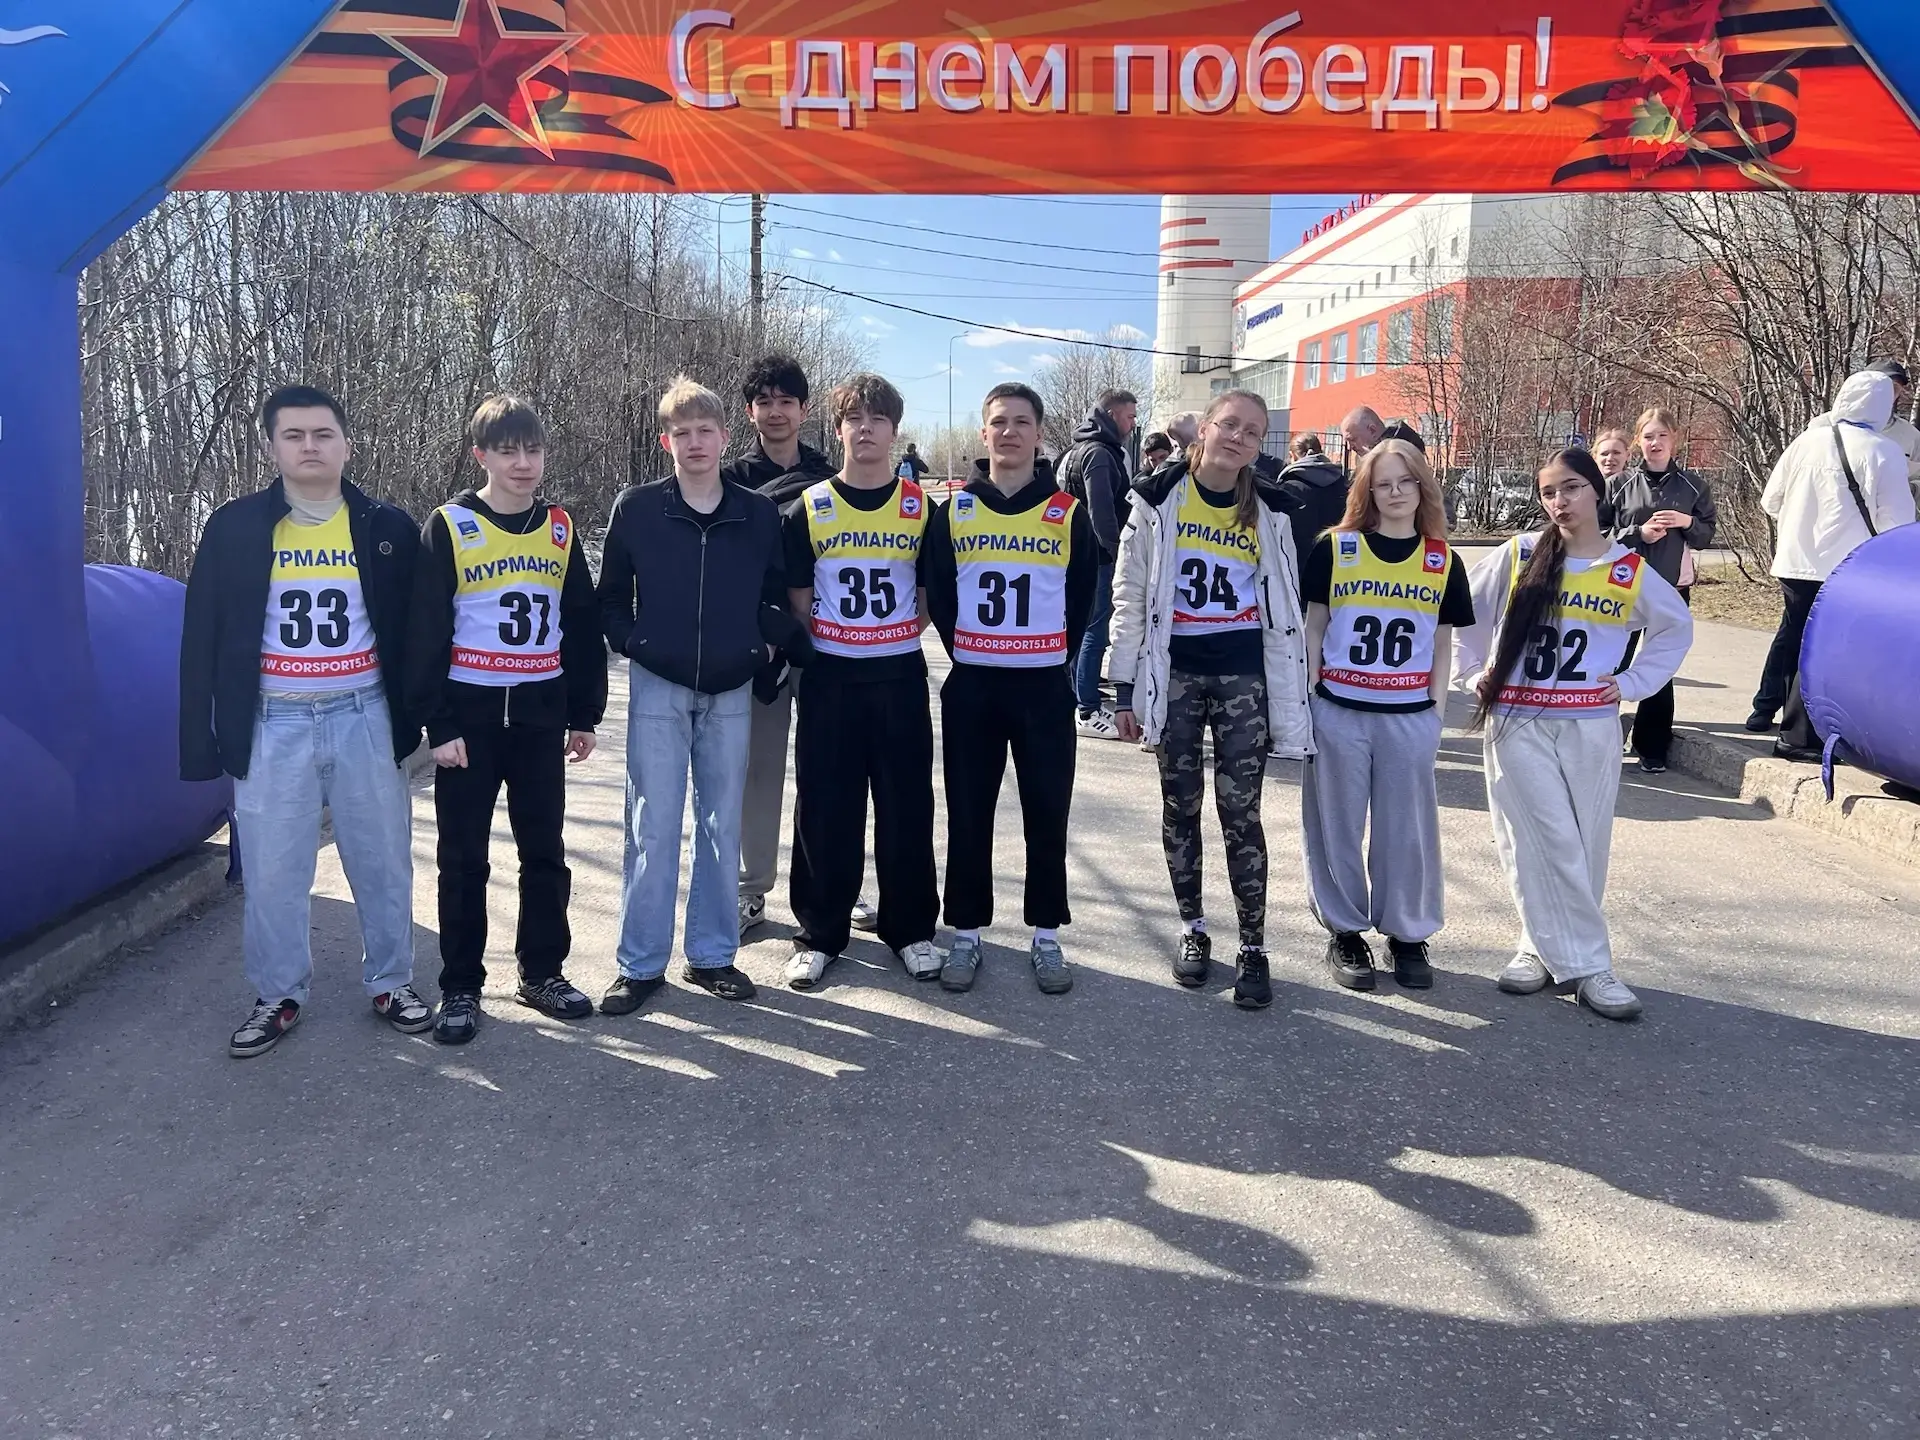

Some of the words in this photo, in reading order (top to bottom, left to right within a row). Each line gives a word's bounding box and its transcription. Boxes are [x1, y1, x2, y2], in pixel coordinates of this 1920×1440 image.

[667, 9, 740, 111] С
[780, 40, 1069, 130] днем
[1113, 10, 1554, 131] победы!
[817, 531, 921, 554] МУРМАНСК
[952, 534, 1062, 556] МУРМАНСК
[838, 567, 897, 620] 35
[977, 570, 1031, 627] 31
[1179, 558, 1240, 611] 34
[1334, 580, 1442, 605] МУРМАНСК
[280, 588, 350, 649] 33
[498, 591, 551, 646] 37
[1349, 615, 1416, 668] 36
[1524, 625, 1588, 682] 32
